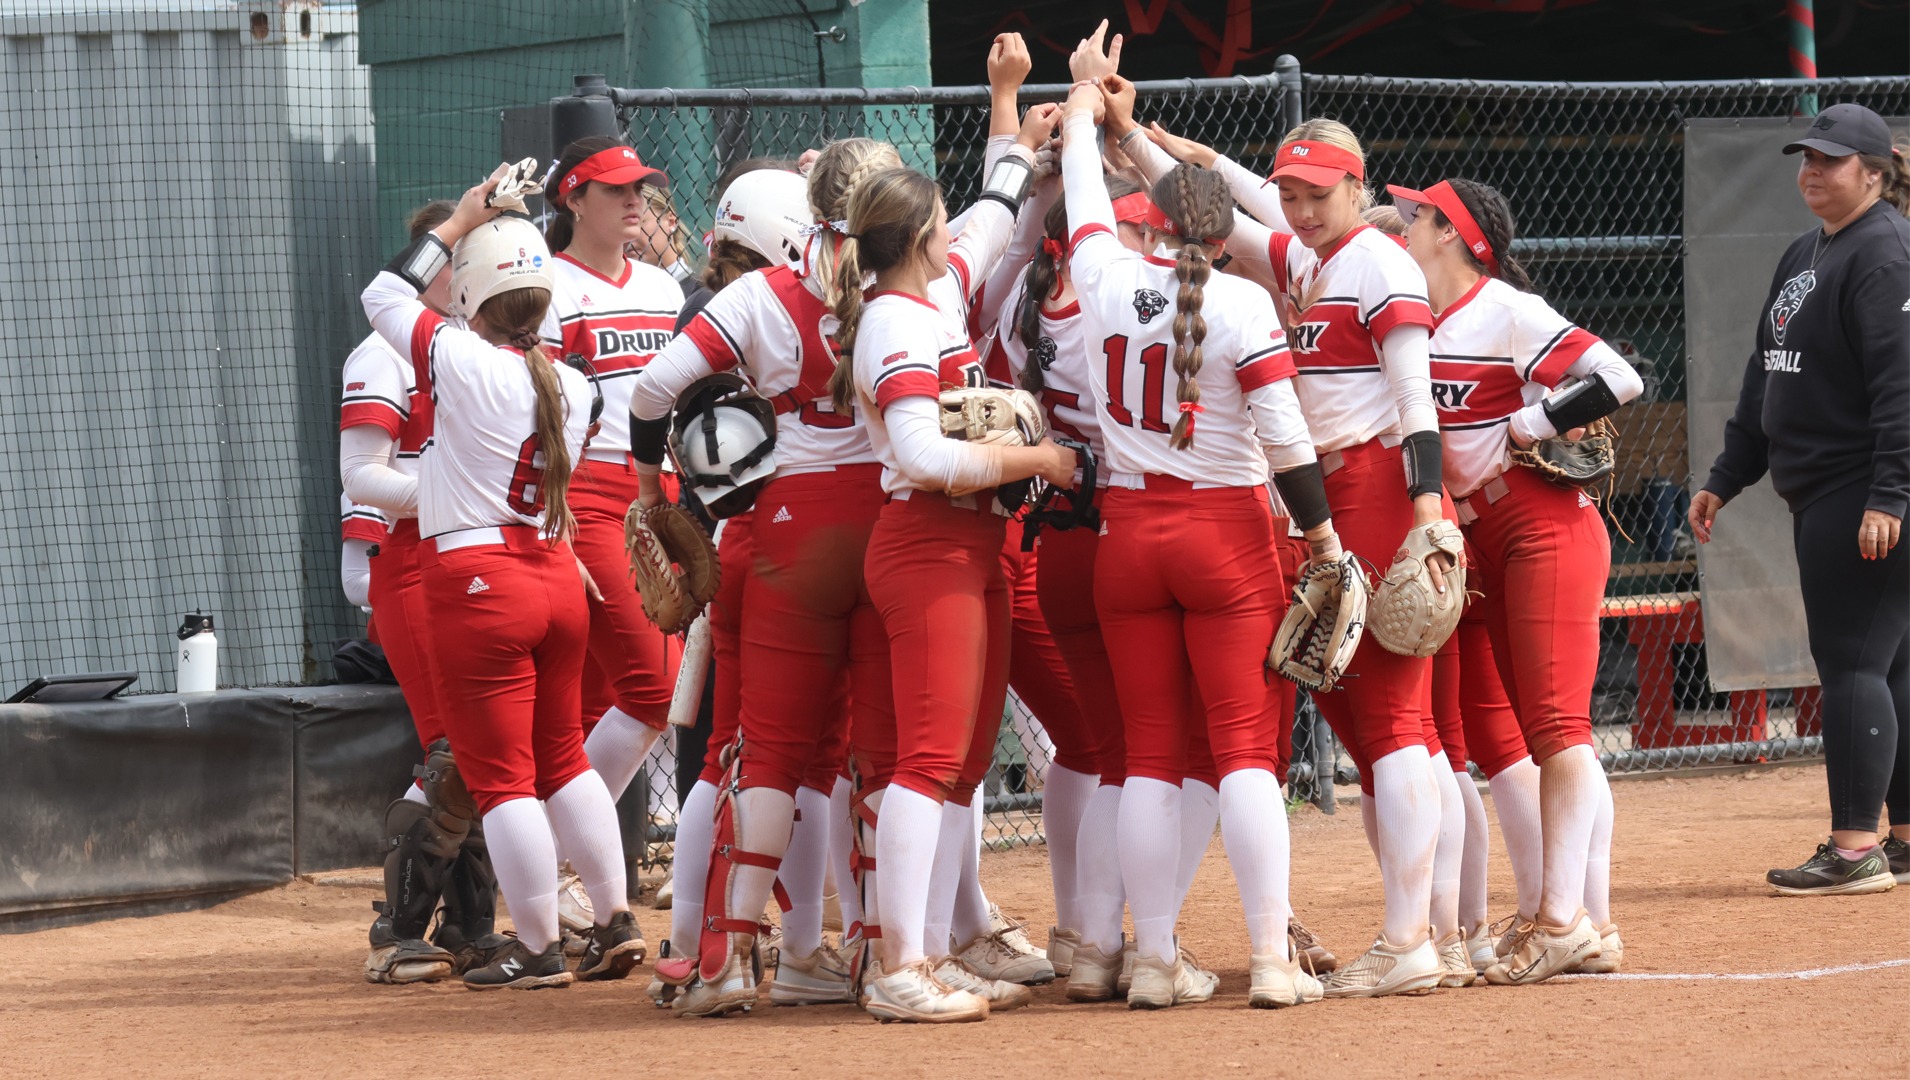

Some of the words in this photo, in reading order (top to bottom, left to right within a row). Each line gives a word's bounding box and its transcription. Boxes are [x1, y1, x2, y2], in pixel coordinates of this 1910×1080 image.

[1290, 145, 1311, 156] DU
[567, 174, 577, 188] 33
[725, 200, 732, 212] 2
[518, 247, 526, 258] 6
[1103, 333, 1171, 434] 11
[500, 957, 524, 977] N
